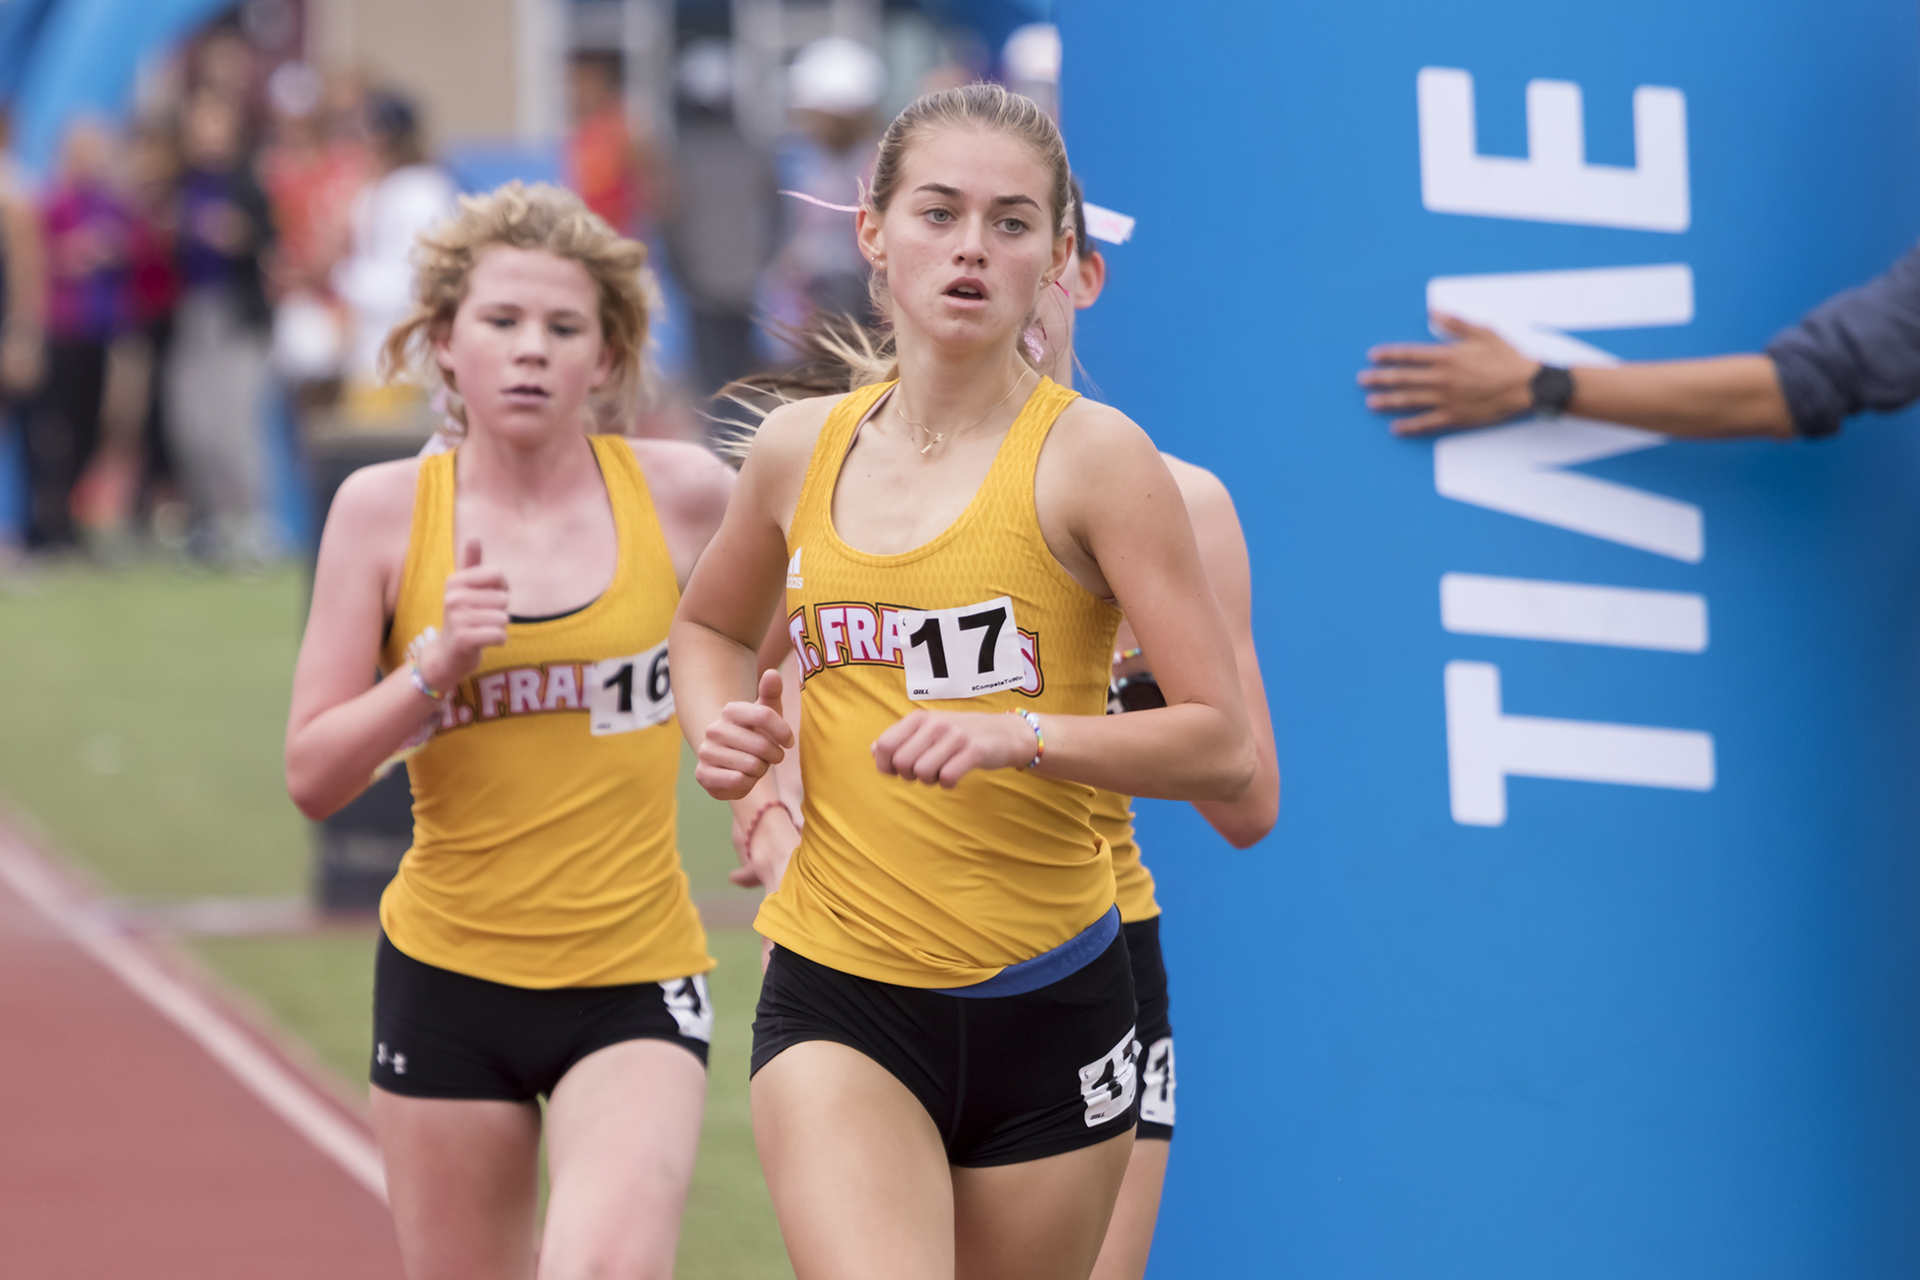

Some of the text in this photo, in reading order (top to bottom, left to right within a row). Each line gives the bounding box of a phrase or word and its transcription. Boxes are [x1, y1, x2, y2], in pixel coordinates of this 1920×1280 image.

[1416, 66, 1717, 827] TIME
[909, 606, 1007, 679] 17
[602, 647, 671, 714] 16
[913, 688, 930, 696] GILL
